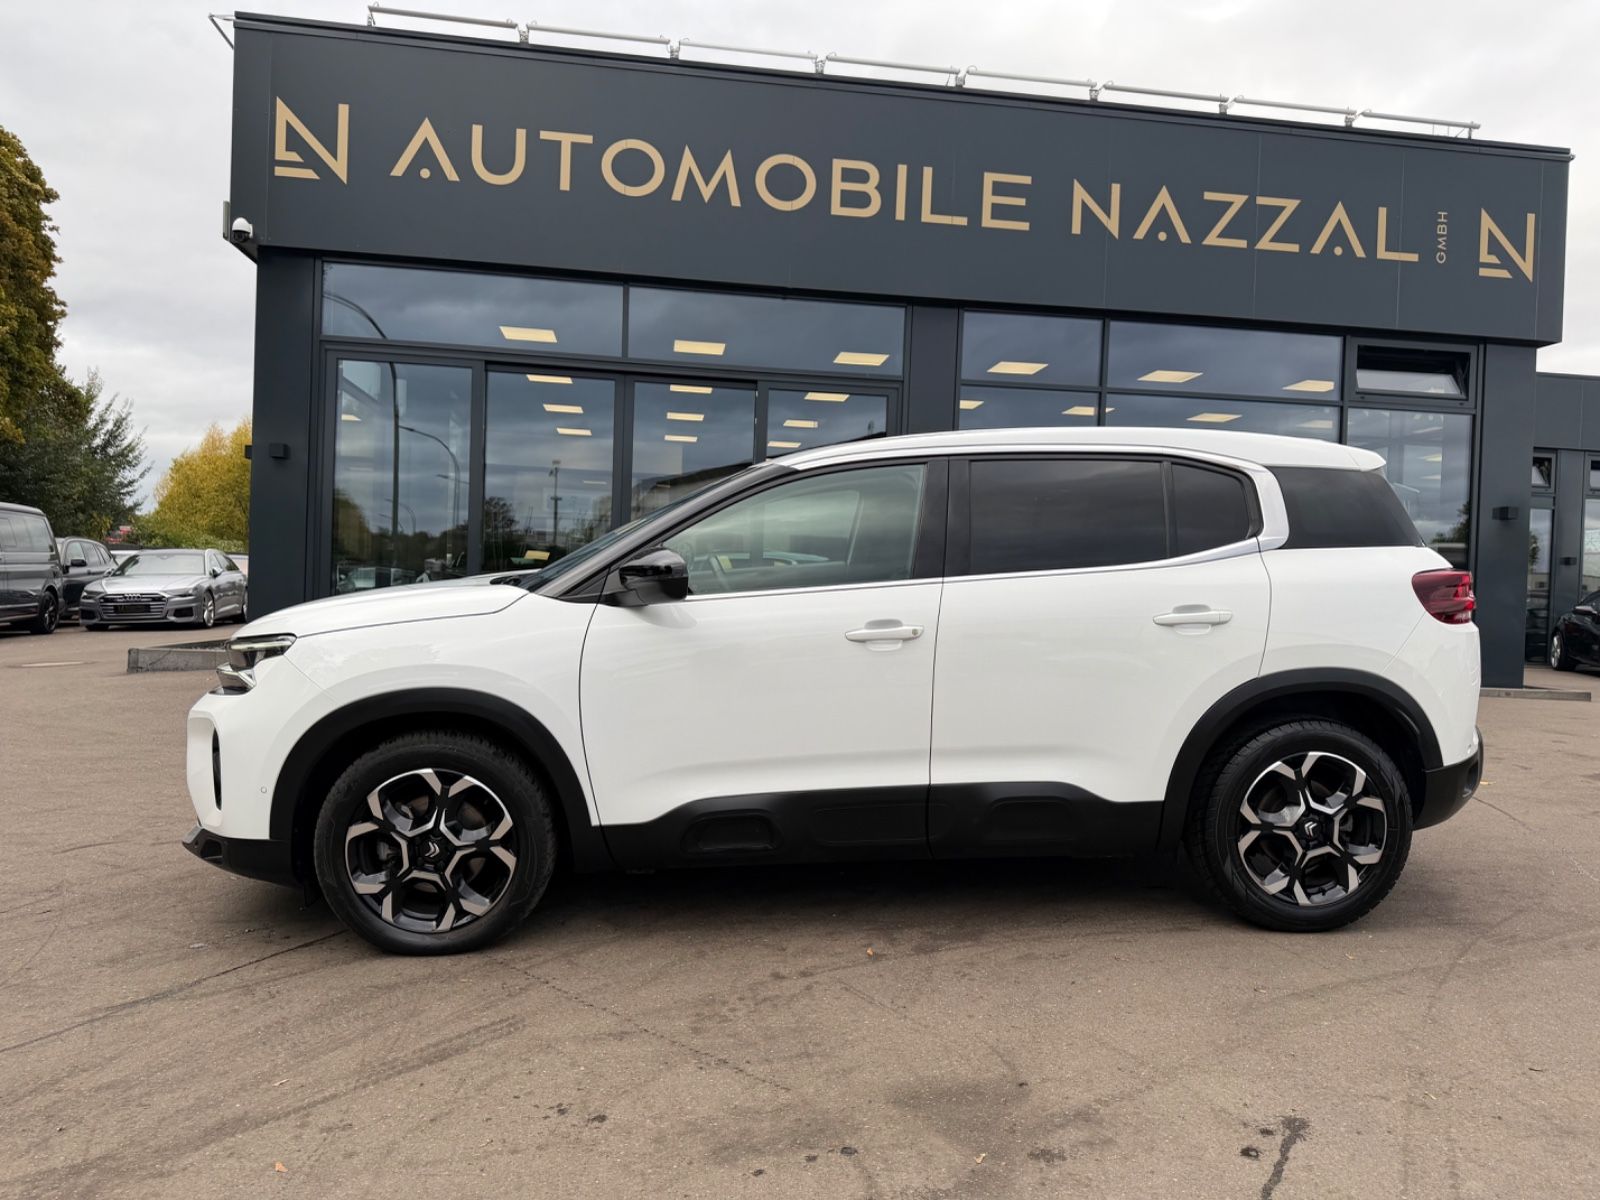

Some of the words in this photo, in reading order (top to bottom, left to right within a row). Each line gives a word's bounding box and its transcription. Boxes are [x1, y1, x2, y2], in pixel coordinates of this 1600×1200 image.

[391, 118, 1032, 232] AUTOMOBILE
[1071, 179, 1419, 263] NAZZAL
[1435, 211, 1449, 265] GMBH
